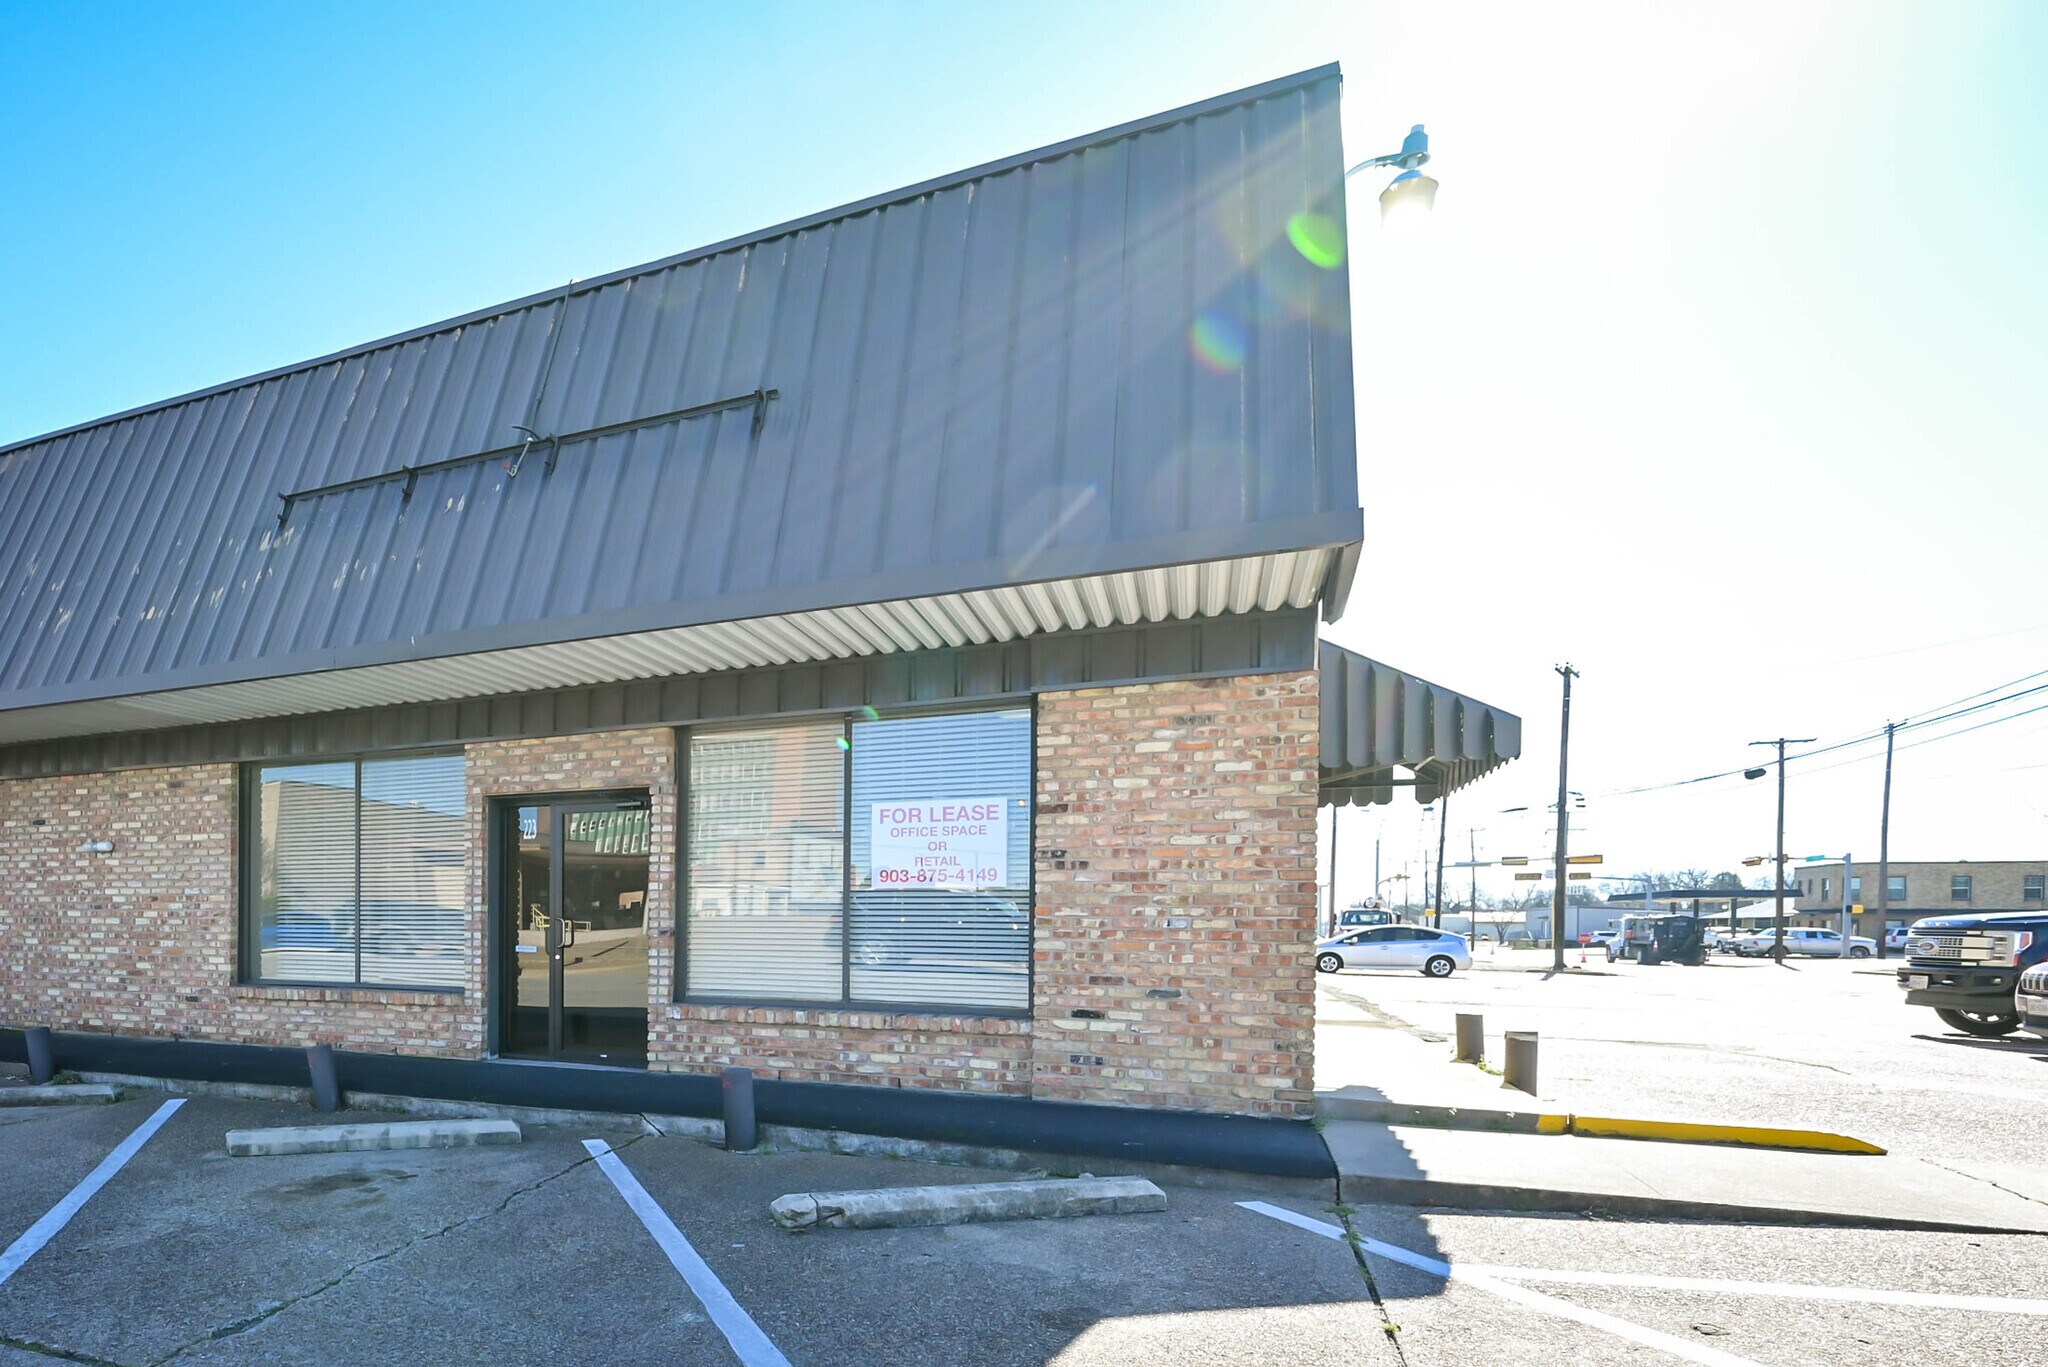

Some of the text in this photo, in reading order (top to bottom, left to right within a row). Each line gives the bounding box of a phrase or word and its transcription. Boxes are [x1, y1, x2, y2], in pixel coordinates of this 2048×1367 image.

[879, 804, 999, 824] FOR LEASE
[523, 819, 537, 840] 223
[890, 825, 987, 838] OFFICE SPACE
[927, 841, 948, 851] OR
[914, 856, 961, 867] RETAIL
[879, 868, 998, 883] 903-875-4149
